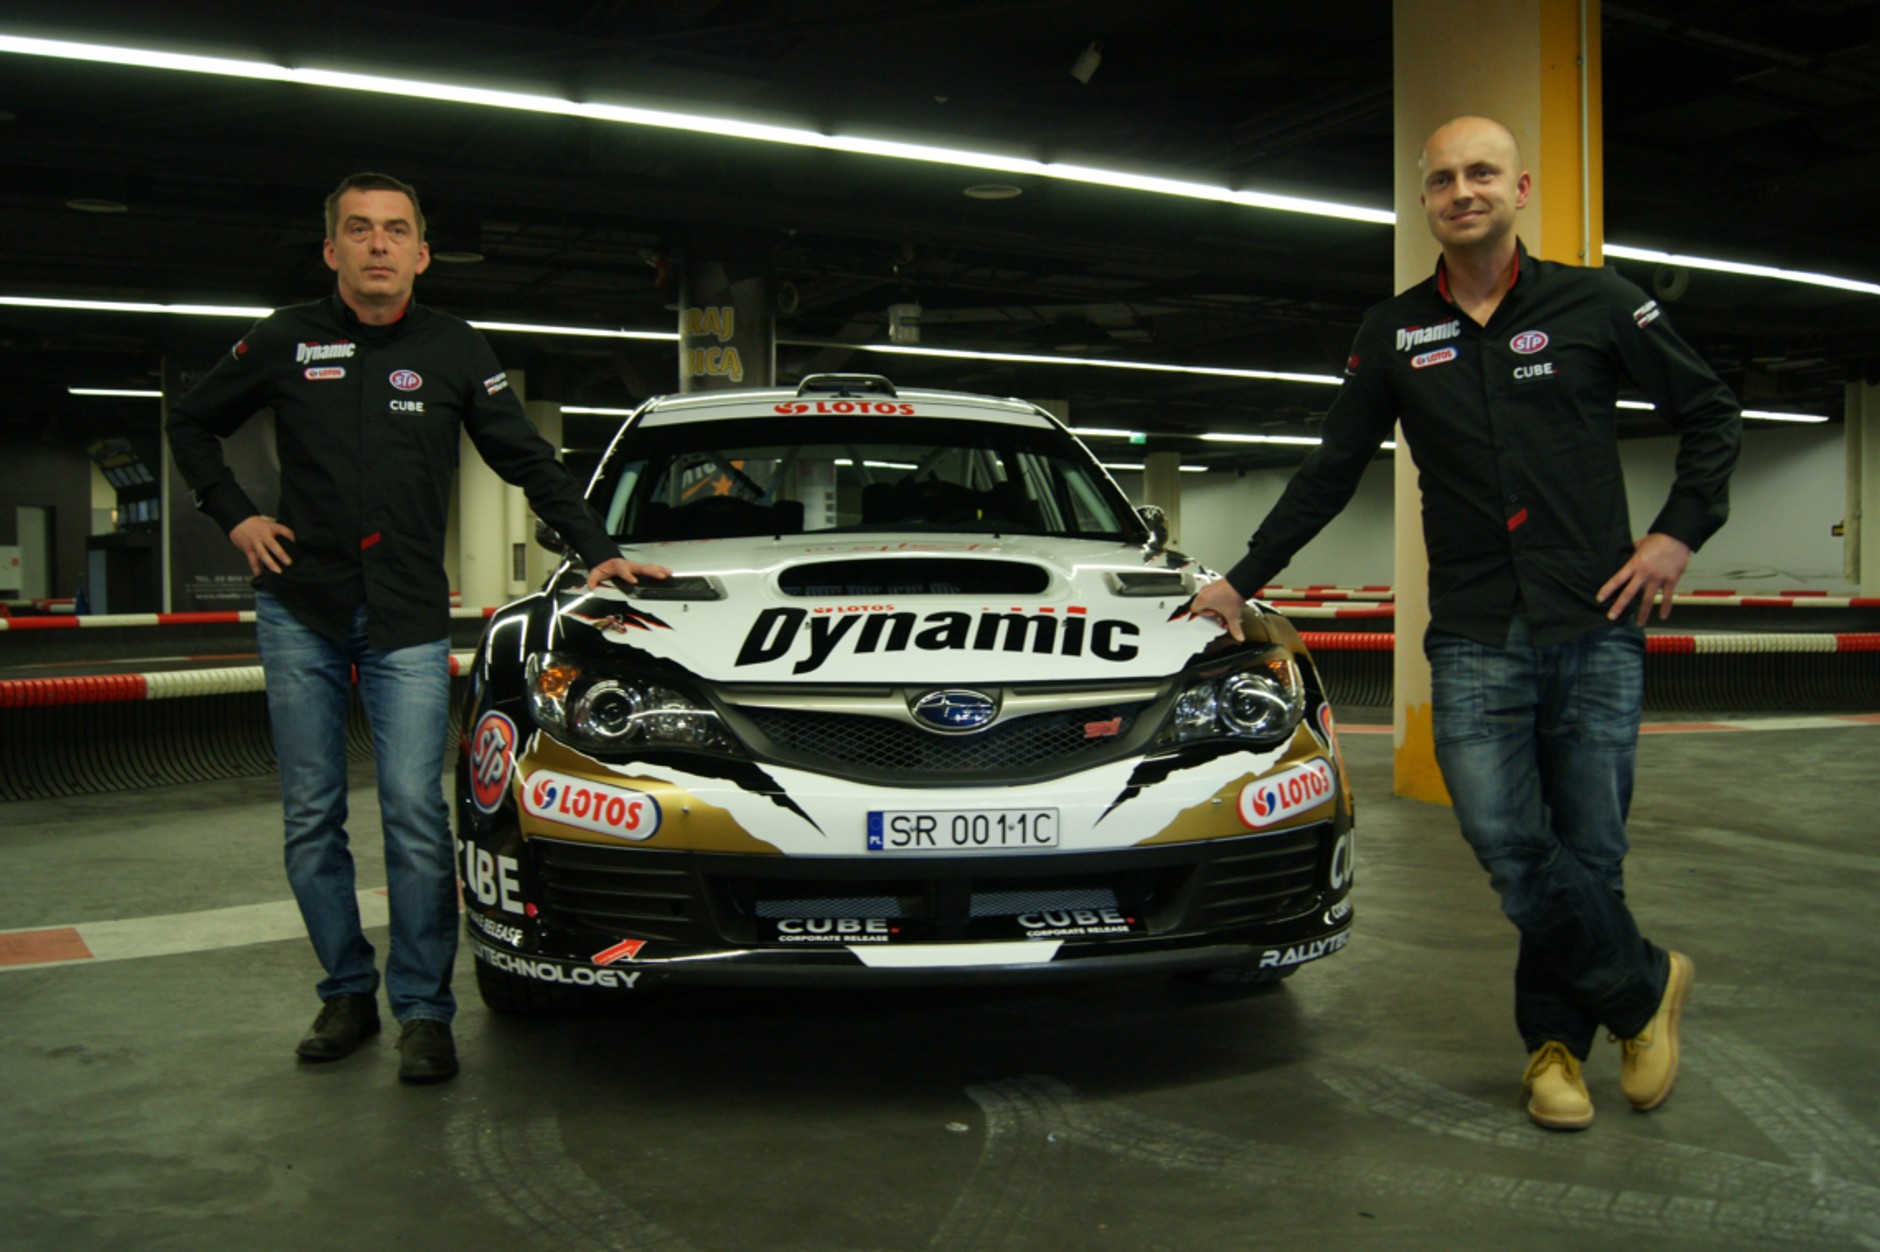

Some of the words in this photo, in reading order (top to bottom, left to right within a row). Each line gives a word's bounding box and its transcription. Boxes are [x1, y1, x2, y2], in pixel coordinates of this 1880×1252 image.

[1396, 319, 1461, 351] Dynamic
[1516, 333, 1542, 349] STP
[296, 342, 356, 364] Dynamic
[394, 372, 417, 387] STP
[816, 401, 915, 415] LOTOS
[837, 604, 895, 613] LOTOS
[733, 605, 1141, 675] Dynamic
[473, 726, 507, 788] STP
[1277, 765, 1330, 809] LOTOS
[559, 785, 643, 831] LOTOS
[869, 836, 882, 845] PL
[890, 815, 937, 847] SR
[951, 812, 1052, 846] 0011C
[459, 839, 539, 918] UBE.
[1026, 927, 1086, 937] CORPORATE
[1087, 925, 1130, 934] RELEASE
